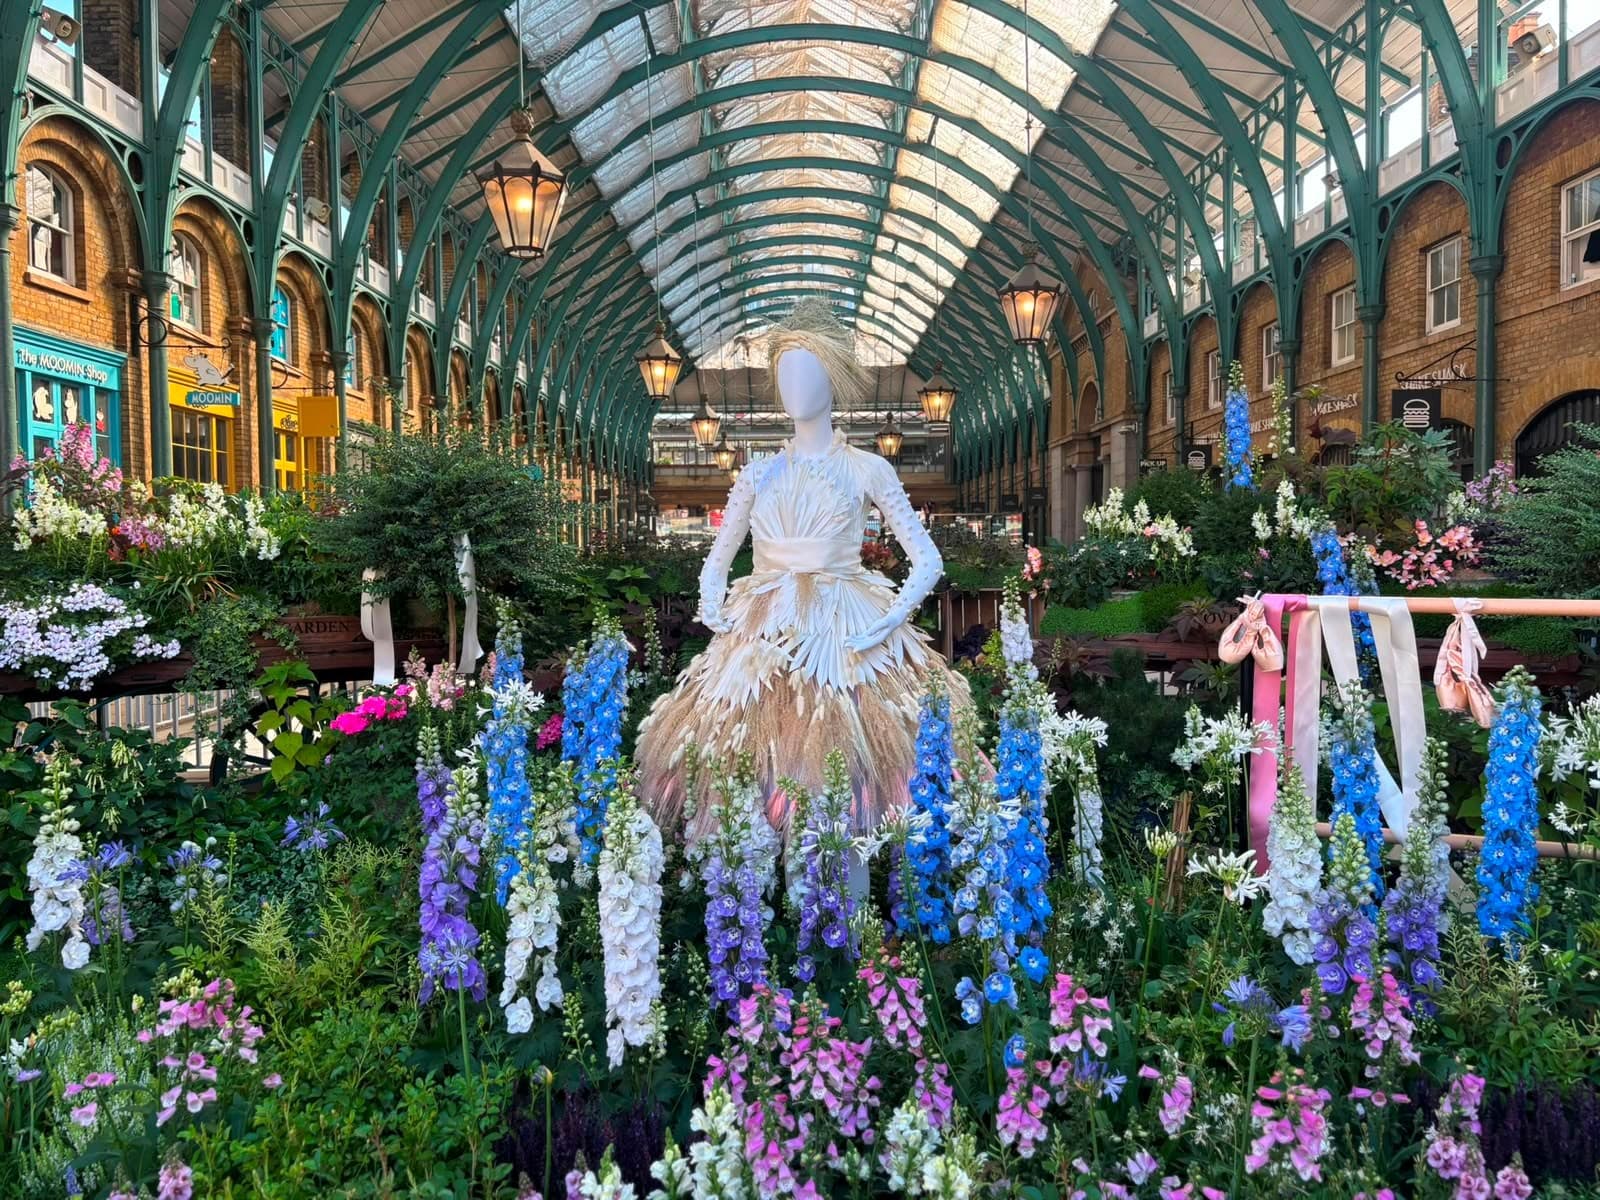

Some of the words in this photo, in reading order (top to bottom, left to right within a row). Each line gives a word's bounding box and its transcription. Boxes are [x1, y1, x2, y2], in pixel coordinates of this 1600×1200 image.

[20, 348, 37, 365] The
[40, 352, 84, 376] MOOMIN
[86, 364, 107, 384] Shop
[191, 393, 232, 404] MOOMIN
[293, 621, 351, 634] ARDEN
